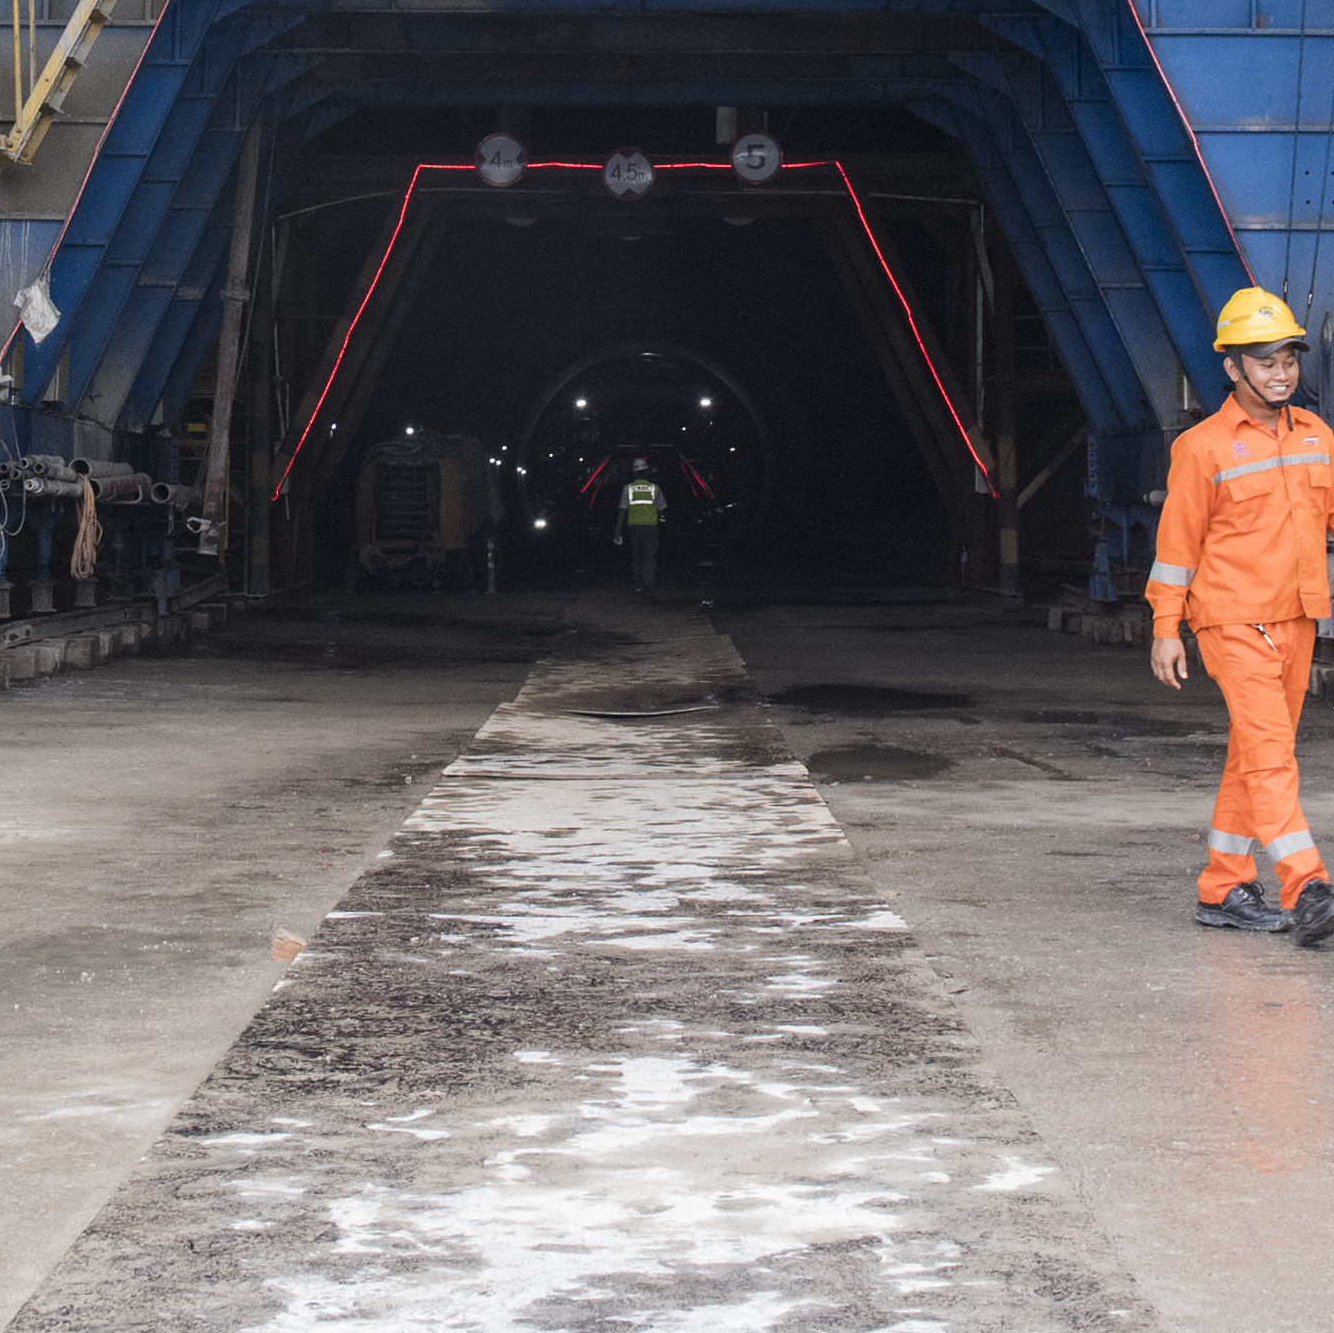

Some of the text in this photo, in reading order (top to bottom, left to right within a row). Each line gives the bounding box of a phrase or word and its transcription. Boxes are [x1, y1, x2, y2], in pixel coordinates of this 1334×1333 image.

[490, 150, 513, 169] 4m
[746, 144, 766, 170] 5
[610, 162, 647, 181] 4.5m
